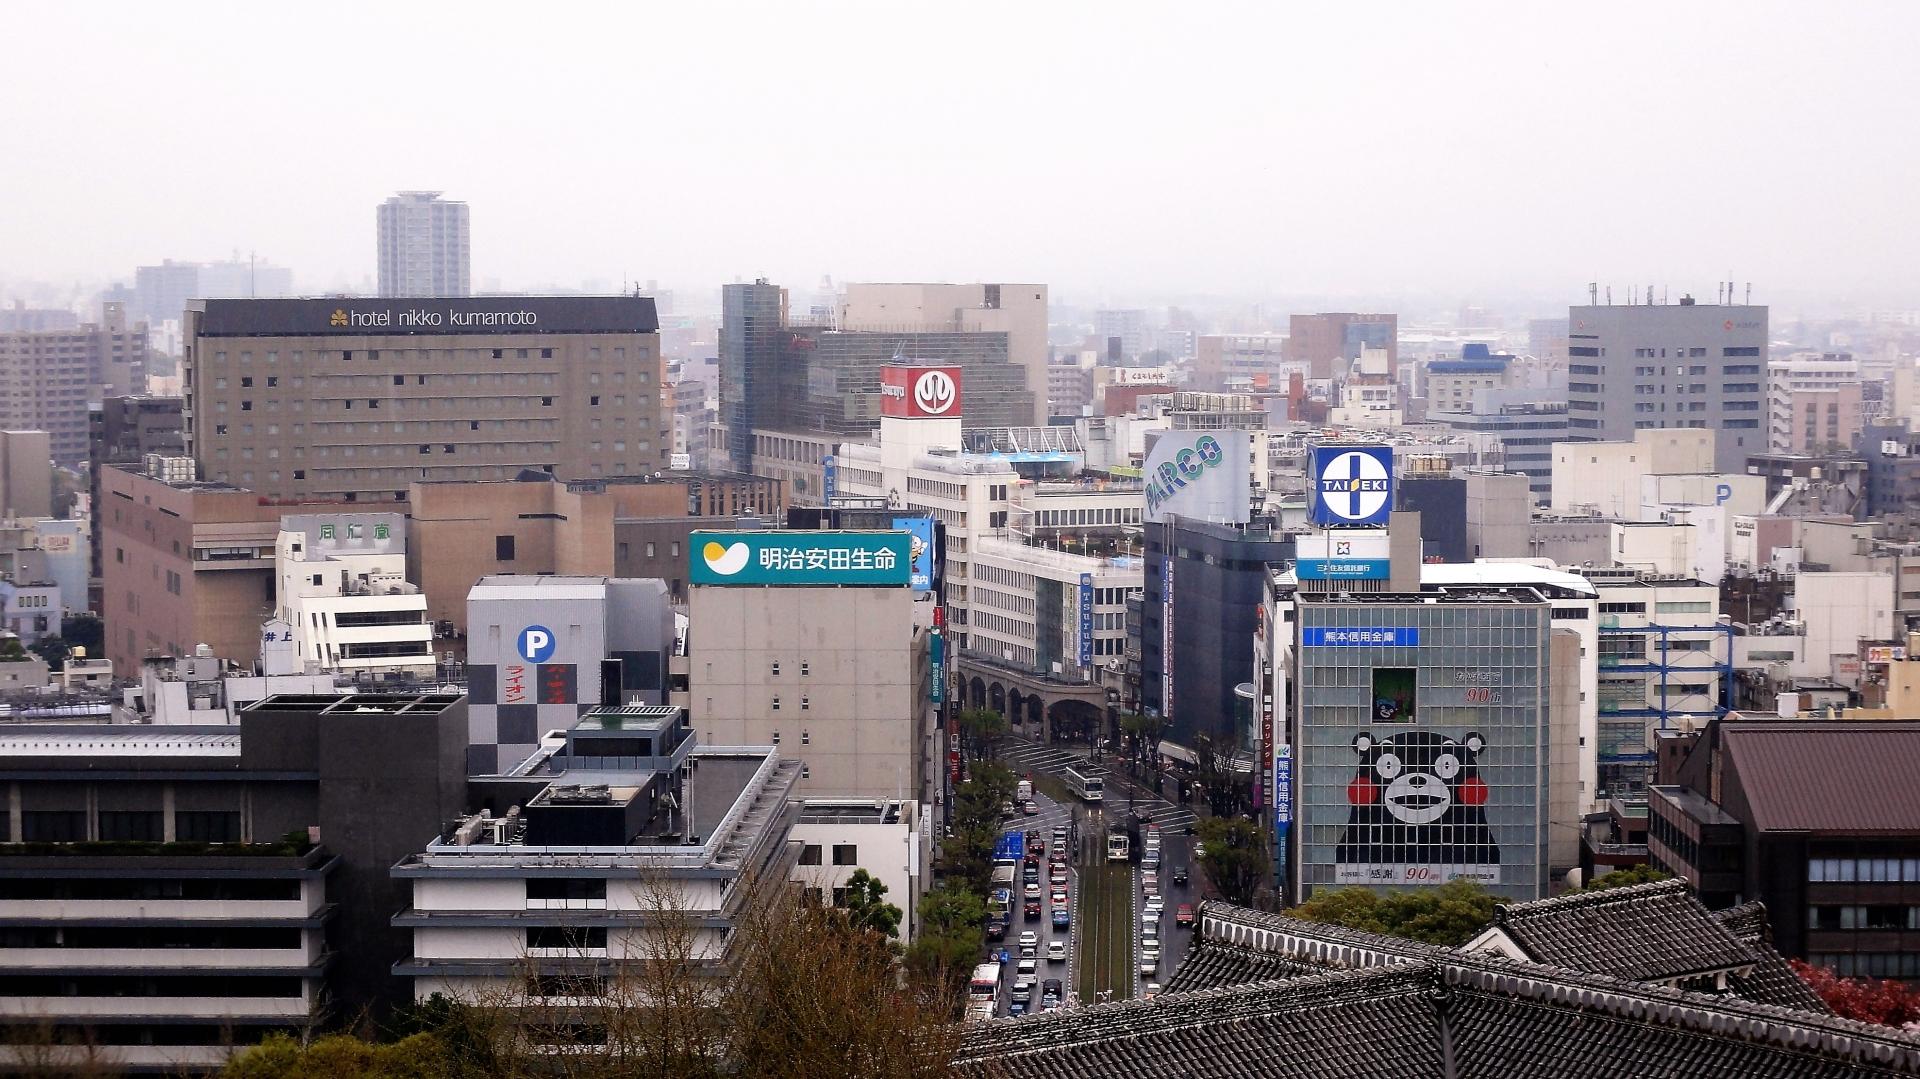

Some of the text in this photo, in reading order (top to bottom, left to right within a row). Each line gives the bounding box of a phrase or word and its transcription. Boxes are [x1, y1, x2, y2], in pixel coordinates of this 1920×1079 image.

[351, 309, 537, 326] hotel nikko kumamoto
[1145, 435, 1223, 518] PARCO
[1717, 484, 1732, 506] P
[319, 524, 390, 539] 同仁堂
[759, 547, 897, 570] 明治安田生命
[265, 631, 292, 641] 井上
[1083, 592, 1091, 661] Tsuruya
[1325, 631, 1394, 642] 熊本信用金庫
[526, 630, 549, 658] P
[1278, 760, 1289, 823] 熊本信用金庫
